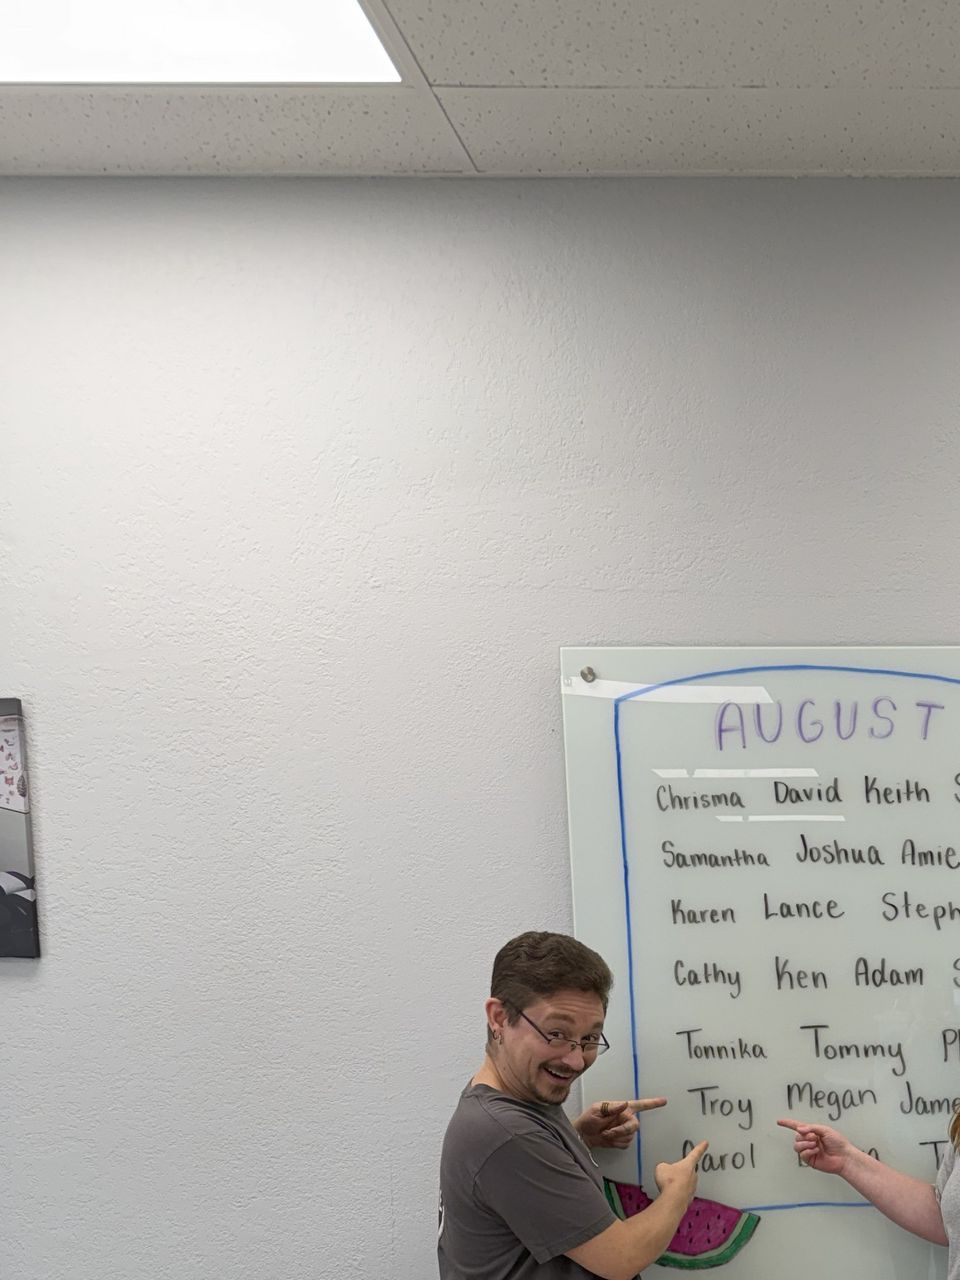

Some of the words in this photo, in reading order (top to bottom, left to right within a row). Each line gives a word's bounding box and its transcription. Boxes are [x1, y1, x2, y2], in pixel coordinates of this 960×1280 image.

[714, 696, 945, 751] AUGUST
[656, 785, 745, 812] Chrisma
[774, 778, 842, 804] David
[864, 775, 930, 804] Keith
[662, 841, 770, 868] Samantha
[796, 834, 885, 865] Joshua
[901, 839, 960, 869] Amie
[671, 899, 735, 924] Karen
[764, 893, 845, 920] Lance
[674, 960, 741, 999] Cathy
[775, 956, 827, 990] Ken
[855, 957, 923, 988] Adam
[676, 1029, 767, 1059] Tonnika
[800, 1025, 906, 1076] Tommy
[687, 1086, 752, 1130] Troy
[787, 1082, 876, 1121] Megan
